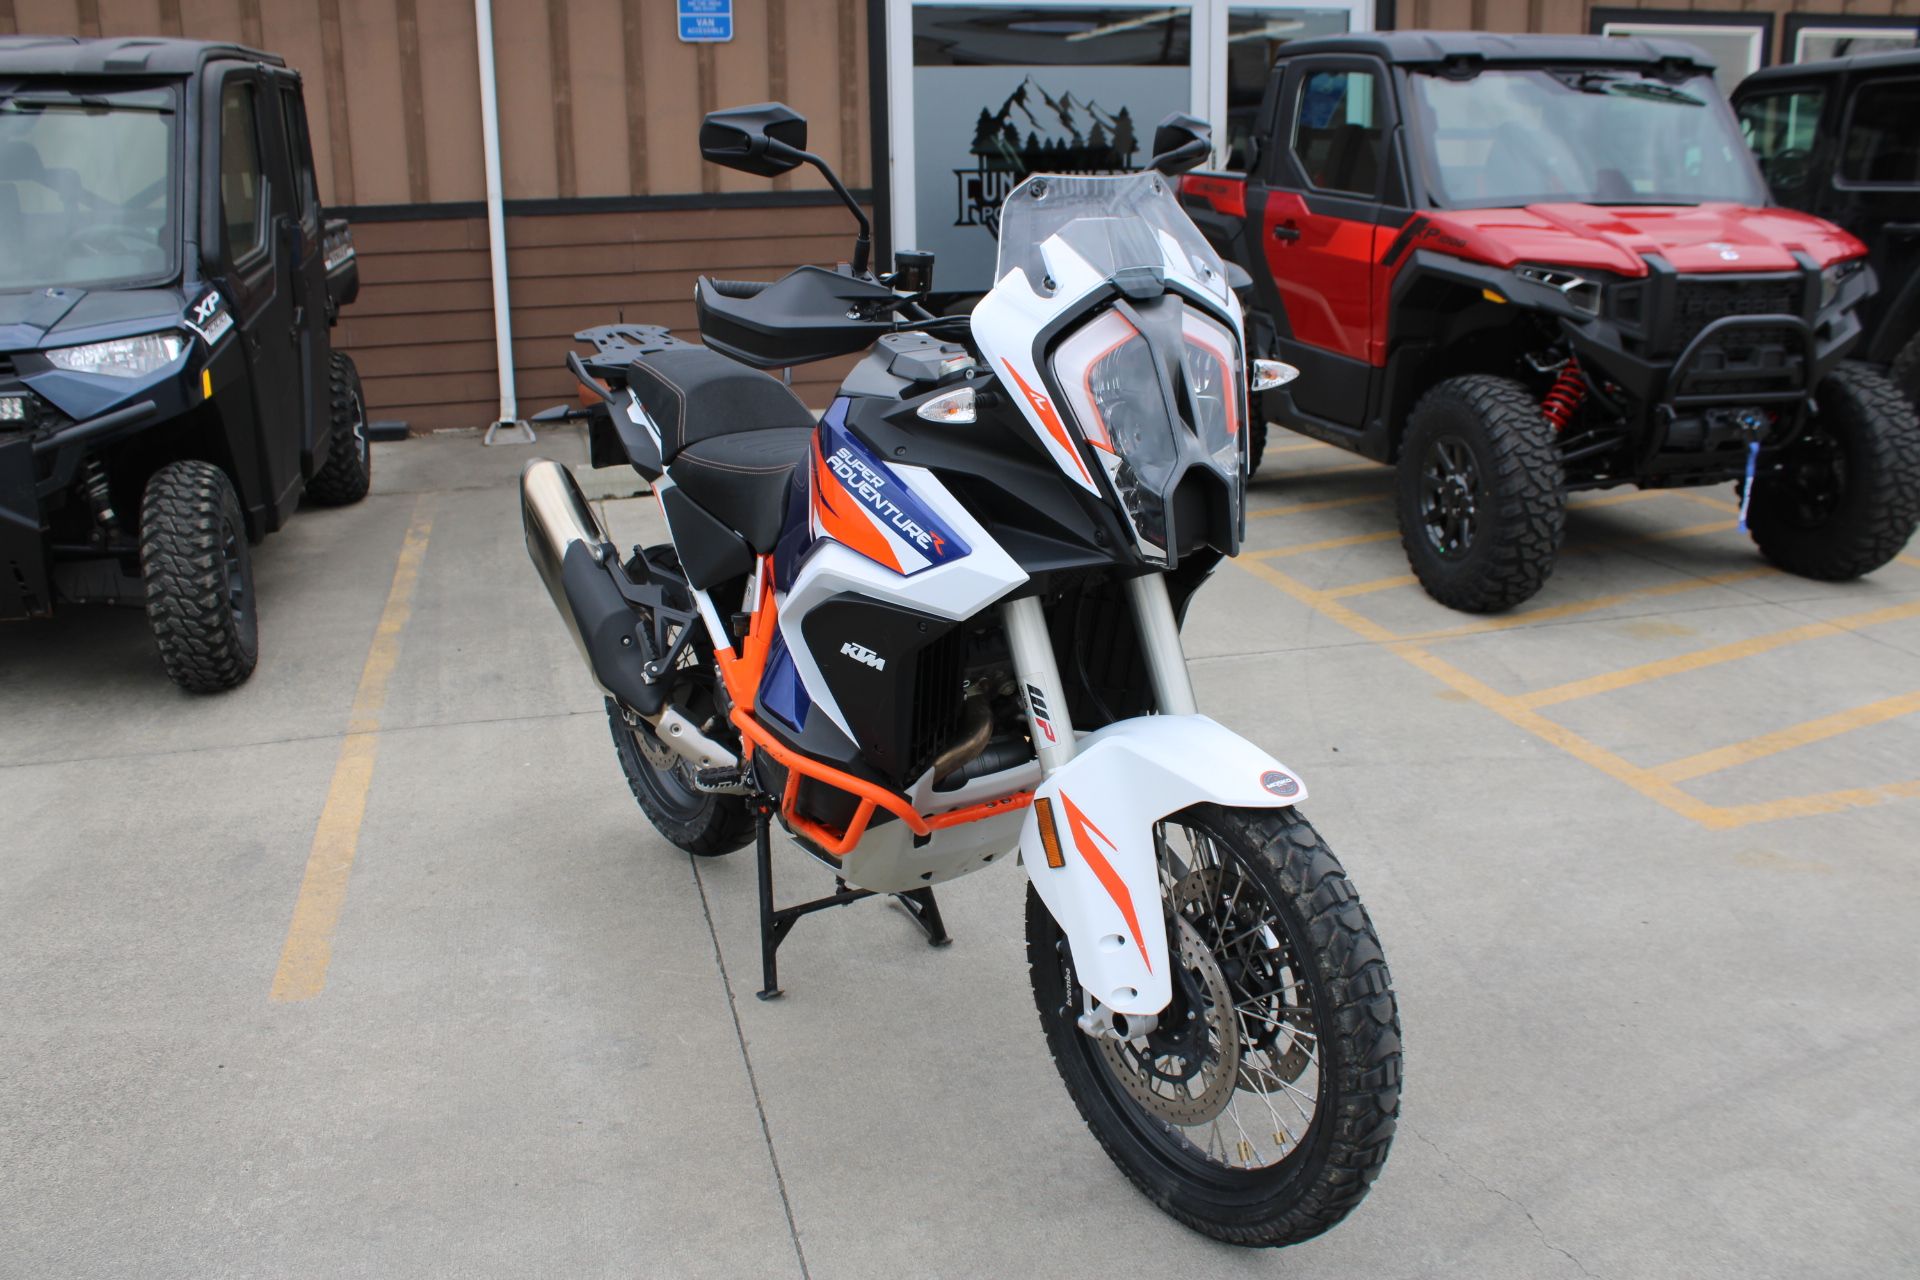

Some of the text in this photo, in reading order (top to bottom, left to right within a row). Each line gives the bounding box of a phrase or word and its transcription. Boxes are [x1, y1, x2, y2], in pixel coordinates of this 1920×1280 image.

[696, 17, 715, 27] VAN
[952, 169, 1015, 226] FUN
[193, 290, 220, 325] XP
[836, 447, 885, 488] SUPER
[826, 455, 933, 550] ADVENTURE
[840, 642, 886, 672] KTM
[1064, 967, 1072, 1007] brembo
